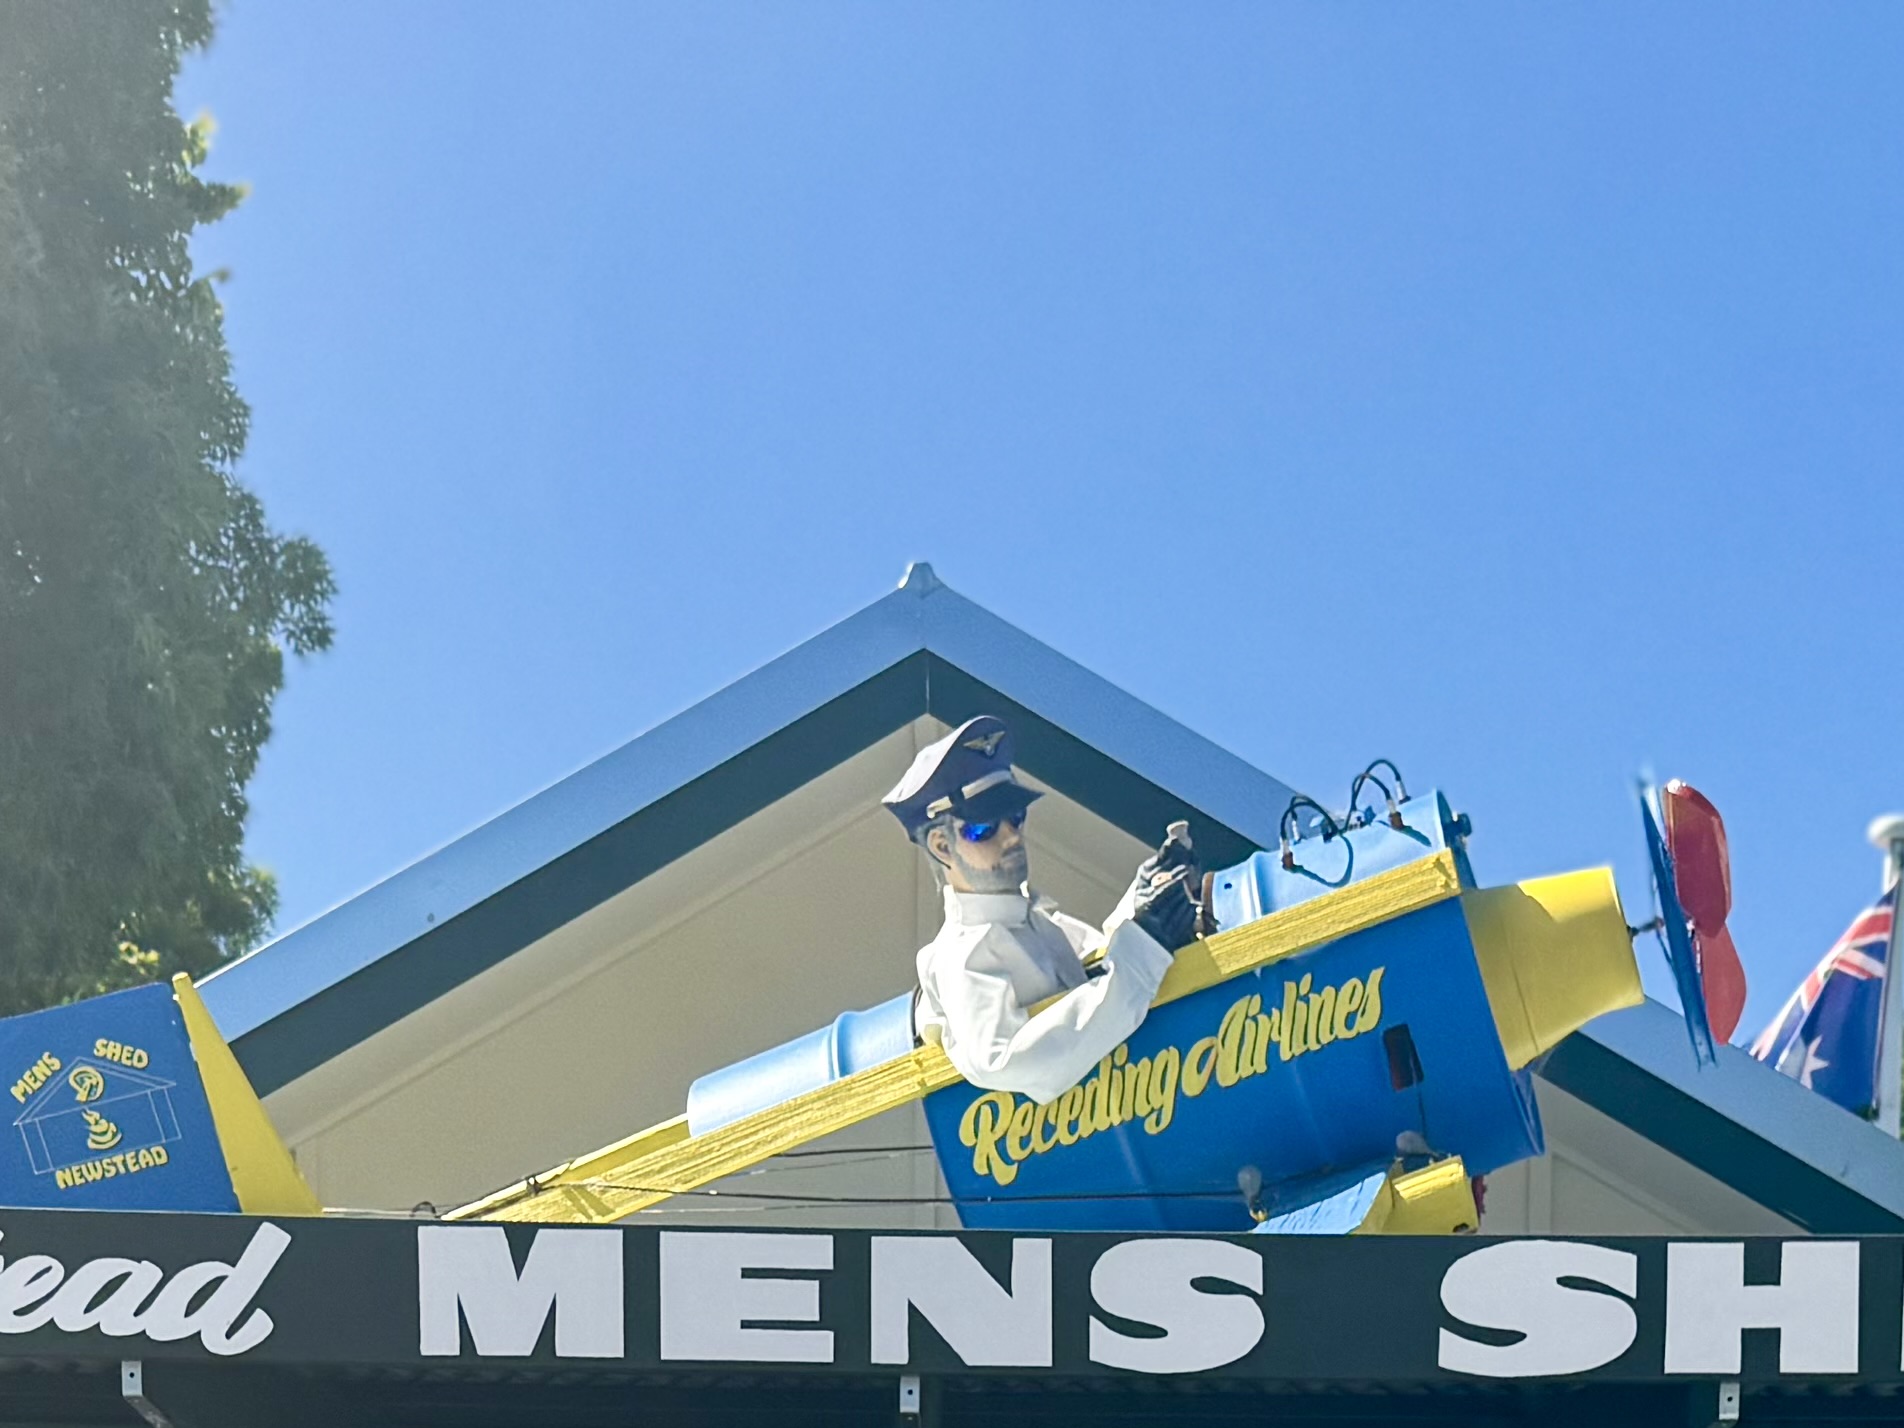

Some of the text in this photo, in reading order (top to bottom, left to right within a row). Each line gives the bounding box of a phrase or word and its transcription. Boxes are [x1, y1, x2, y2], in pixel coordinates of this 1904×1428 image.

[10, 1038, 149, 1104] MENS SHED
[959, 966, 1385, 1185] Receding Airlines
[55, 1146, 169, 1190] NEWSTEAD
[418, 1226, 1264, 1373] MENS
